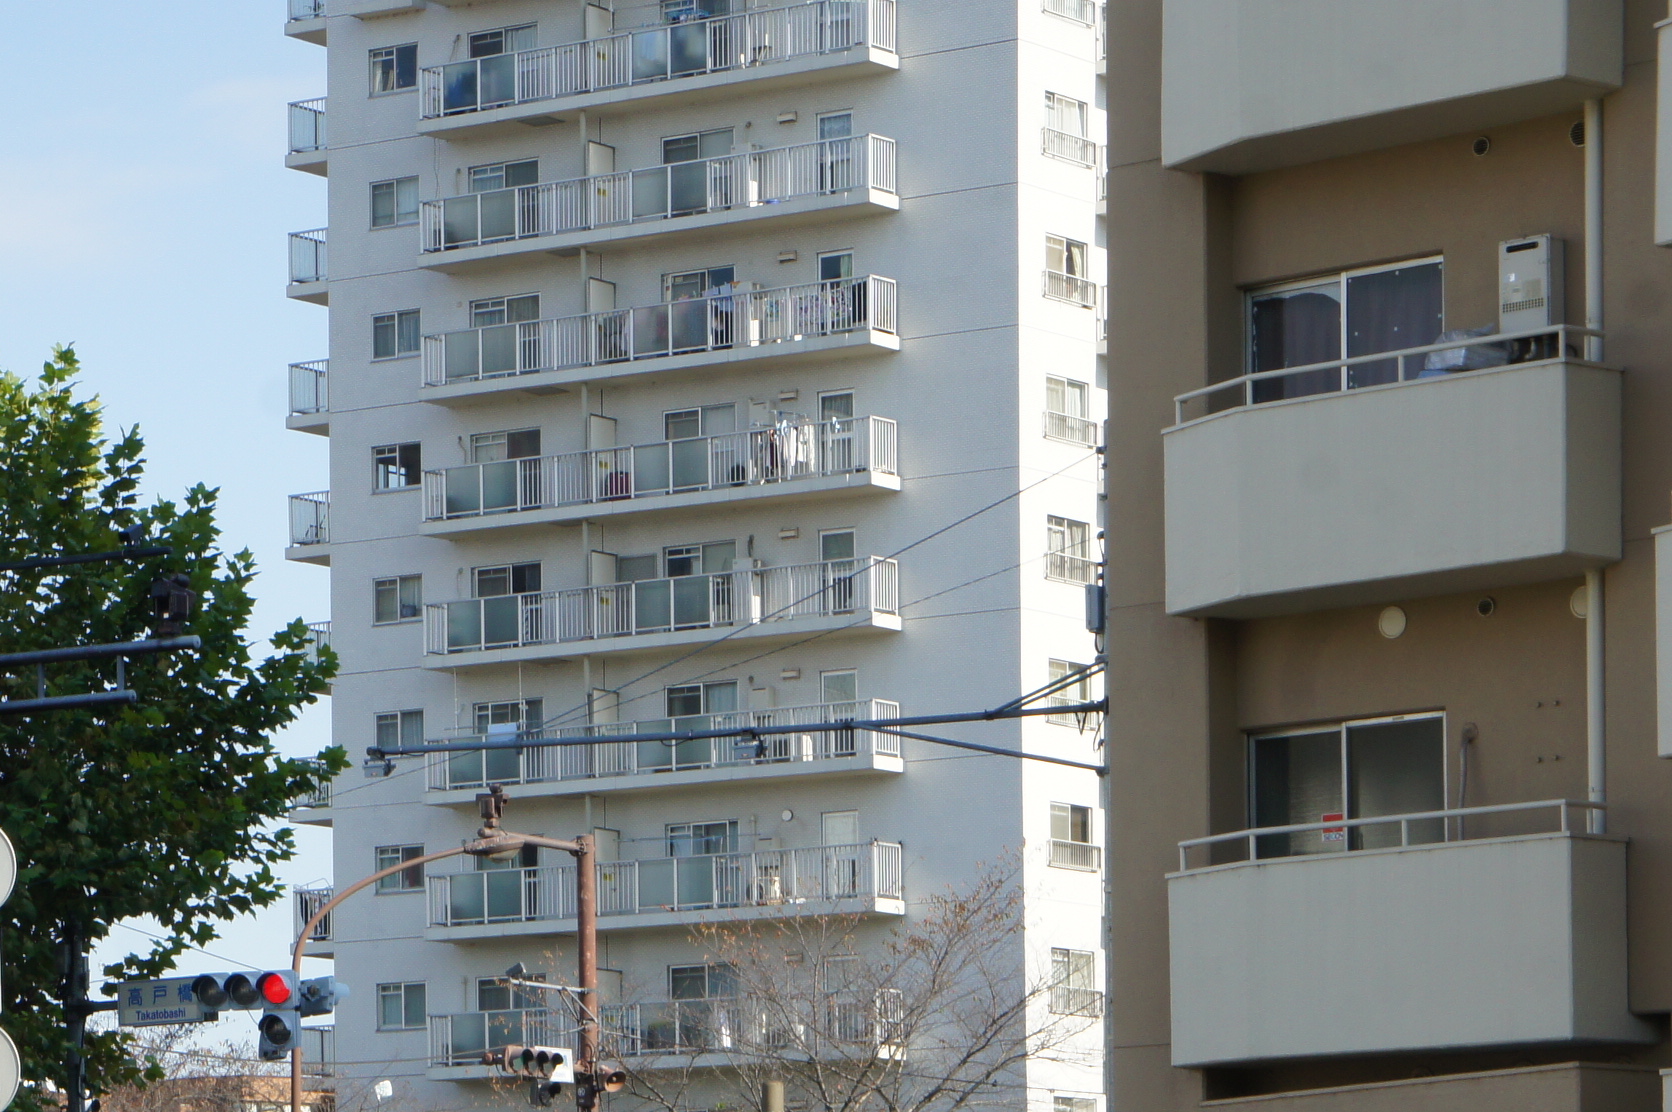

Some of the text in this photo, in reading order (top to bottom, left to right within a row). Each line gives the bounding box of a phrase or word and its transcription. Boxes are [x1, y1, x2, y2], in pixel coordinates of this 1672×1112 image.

[128, 983, 193, 1006] 高戸橋
[136, 1008, 186, 1021] Takatobashi
